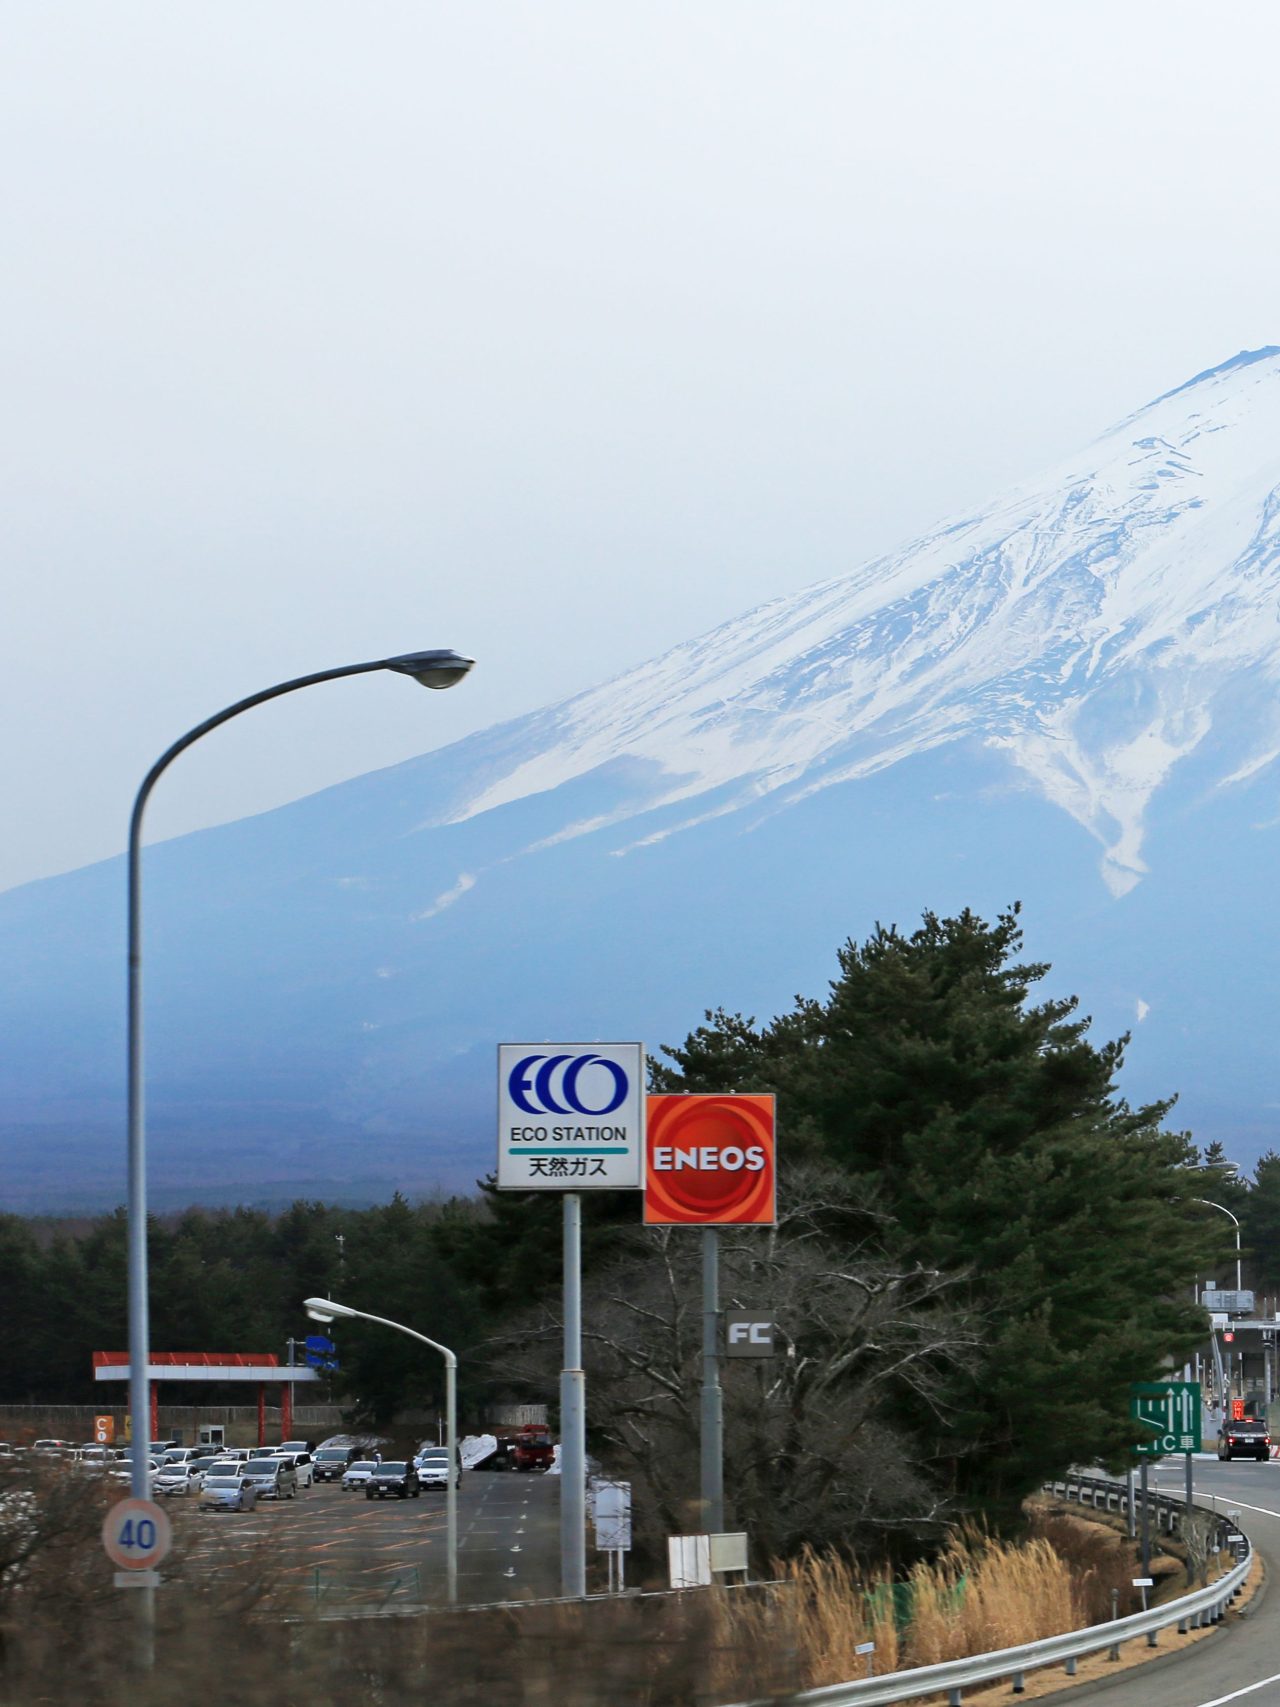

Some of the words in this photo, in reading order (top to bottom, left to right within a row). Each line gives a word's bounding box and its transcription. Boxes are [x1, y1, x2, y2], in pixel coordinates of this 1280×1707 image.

[510, 1126, 547, 1141] ECO
[552, 1126, 627, 1141] STATION
[528, 1156, 608, 1177] 天然ガス
[653, 1146, 766, 1171] ENEOS
[729, 1322, 772, 1344] FC
[96, 1418, 107, 1431] C
[118, 1519, 156, 1550] 40
